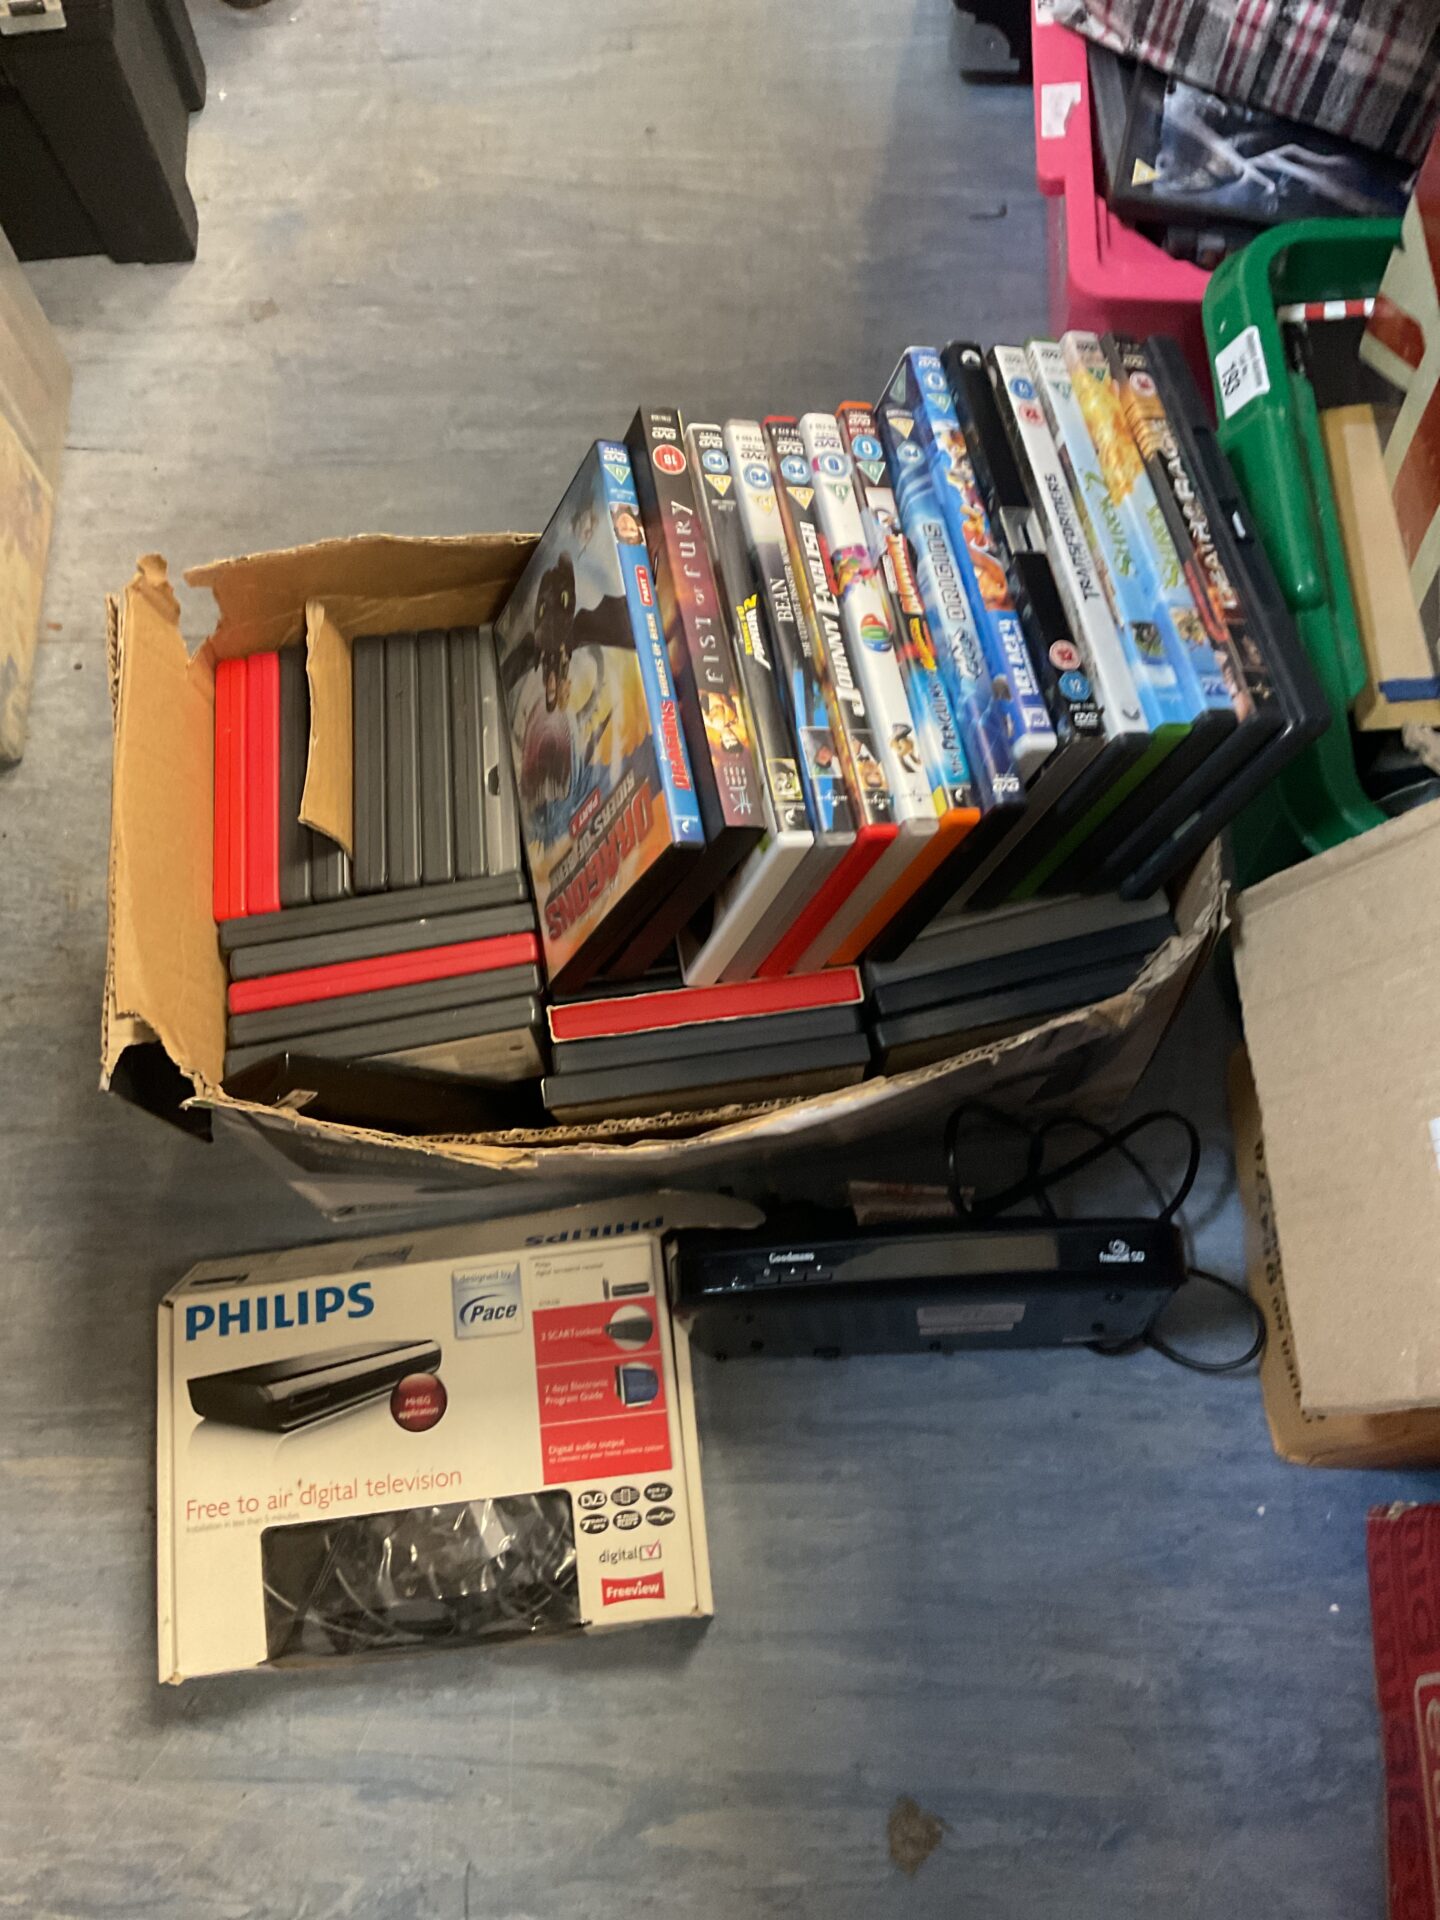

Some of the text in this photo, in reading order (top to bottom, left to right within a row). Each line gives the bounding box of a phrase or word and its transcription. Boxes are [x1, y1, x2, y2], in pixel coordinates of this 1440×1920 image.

[652, 430, 676, 440] DVD
[699, 439, 723, 448] DVD
[815, 439, 841, 448] DVD
[604, 453, 627, 462] DVD
[663, 453, 677, 465] 18
[740, 452, 767, 460] DVD
[777, 445, 804, 454] DVD
[671, 501, 701, 578] FURY
[923, 523, 966, 621] ORIGINS
[639, 577, 650, 602] PART
[744, 594, 757, 611] 2
[770, 578, 794, 622] BEAN
[800, 521, 865, 718] JOHNNY ENGLISH
[651, 642, 661, 656] OF
[695, 616, 724, 683] FIST
[741, 621, 753, 656] KUNG
[1003, 633, 1024, 666] AGE
[655, 658, 670, 697] RIDERS
[1013, 667, 1033, 696] ICE
[661, 699, 691, 791] DRAGONS
[578, 794, 599, 827] PART
[592, 776, 636, 833] RIDERS
[545, 777, 654, 941] DRAGONS
[525, 1216, 664, 1247] PHILIPS
[186, 1282, 375, 1342] PHILIPS
[470, 1304, 518, 1323] Pace
[544, 1391, 605, 1406] Program Guide
[548, 1438, 625, 1456] Digital audio output
[186, 1469, 463, 1520] Free to air digital television
[581, 1492, 606, 1507] DVB
[599, 1546, 638, 1565] digital
[606, 1580, 660, 1599] Freeview
